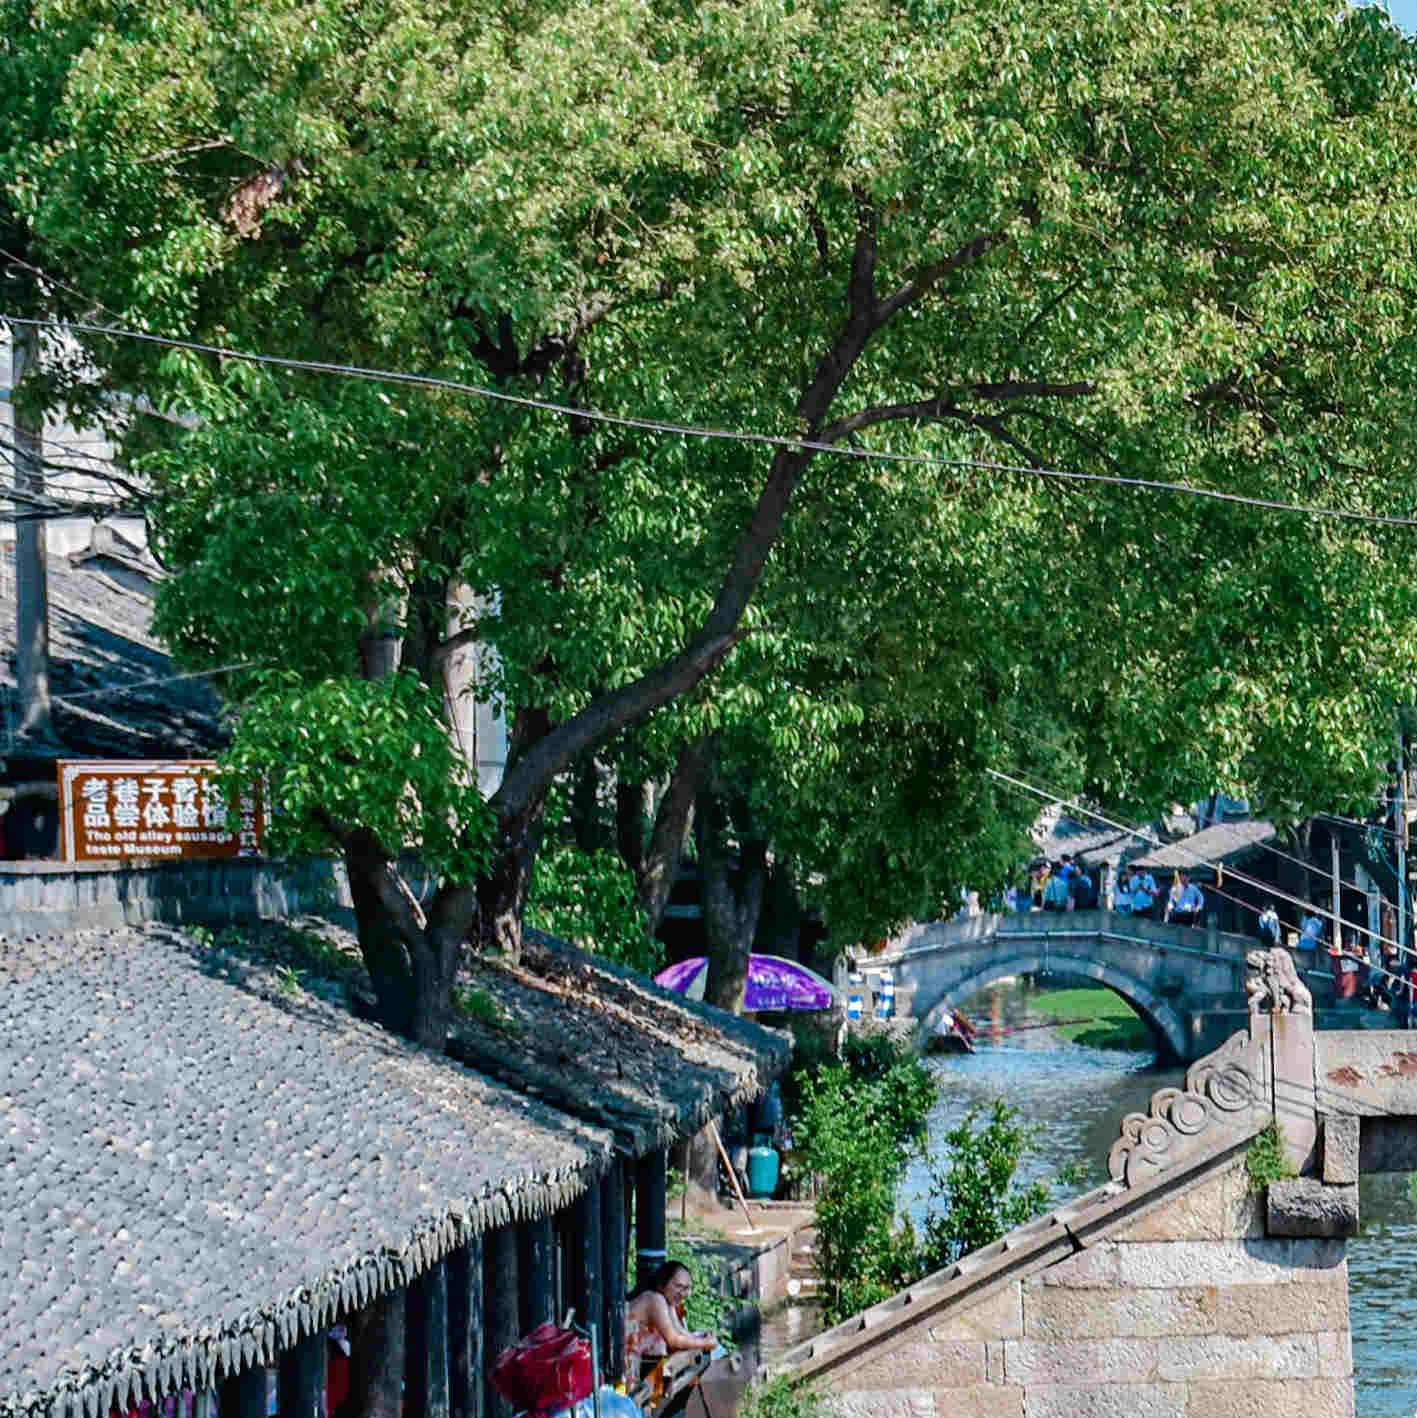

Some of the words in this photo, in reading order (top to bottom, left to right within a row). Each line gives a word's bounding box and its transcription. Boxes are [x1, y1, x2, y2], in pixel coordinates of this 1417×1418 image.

[87, 830, 112, 842] The
[114, 830, 137, 842] old
[139, 829, 173, 844] alley
[123, 843, 182, 856] Museum
